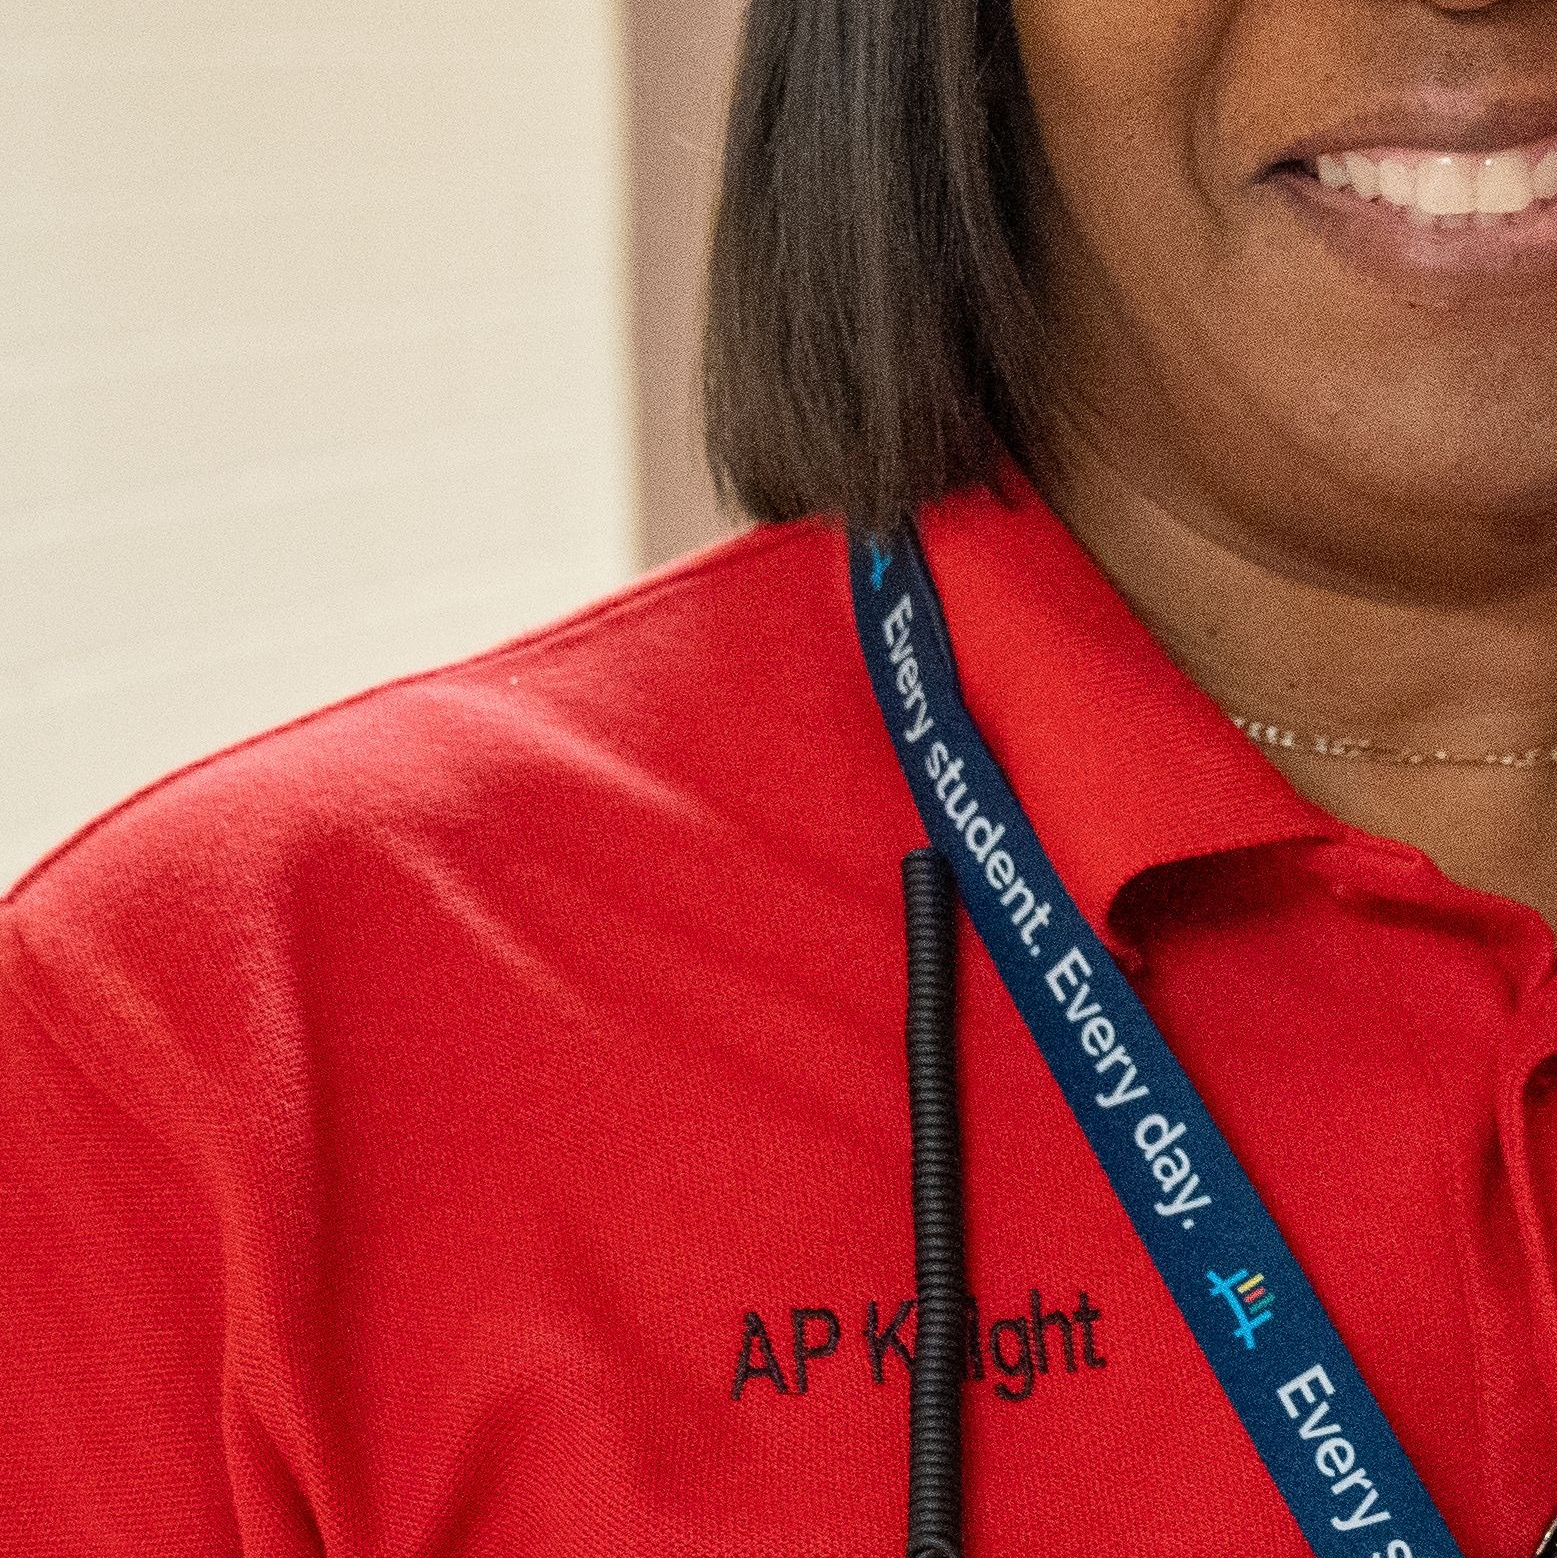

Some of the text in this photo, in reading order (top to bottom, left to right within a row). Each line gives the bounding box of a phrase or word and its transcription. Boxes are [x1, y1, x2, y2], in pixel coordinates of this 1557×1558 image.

[882, 594, 1212, 1230] Every student. Every day.
[731, 1288, 1107, 1401] AP Kight
[1276, 1363, 1391, 1532] Every
